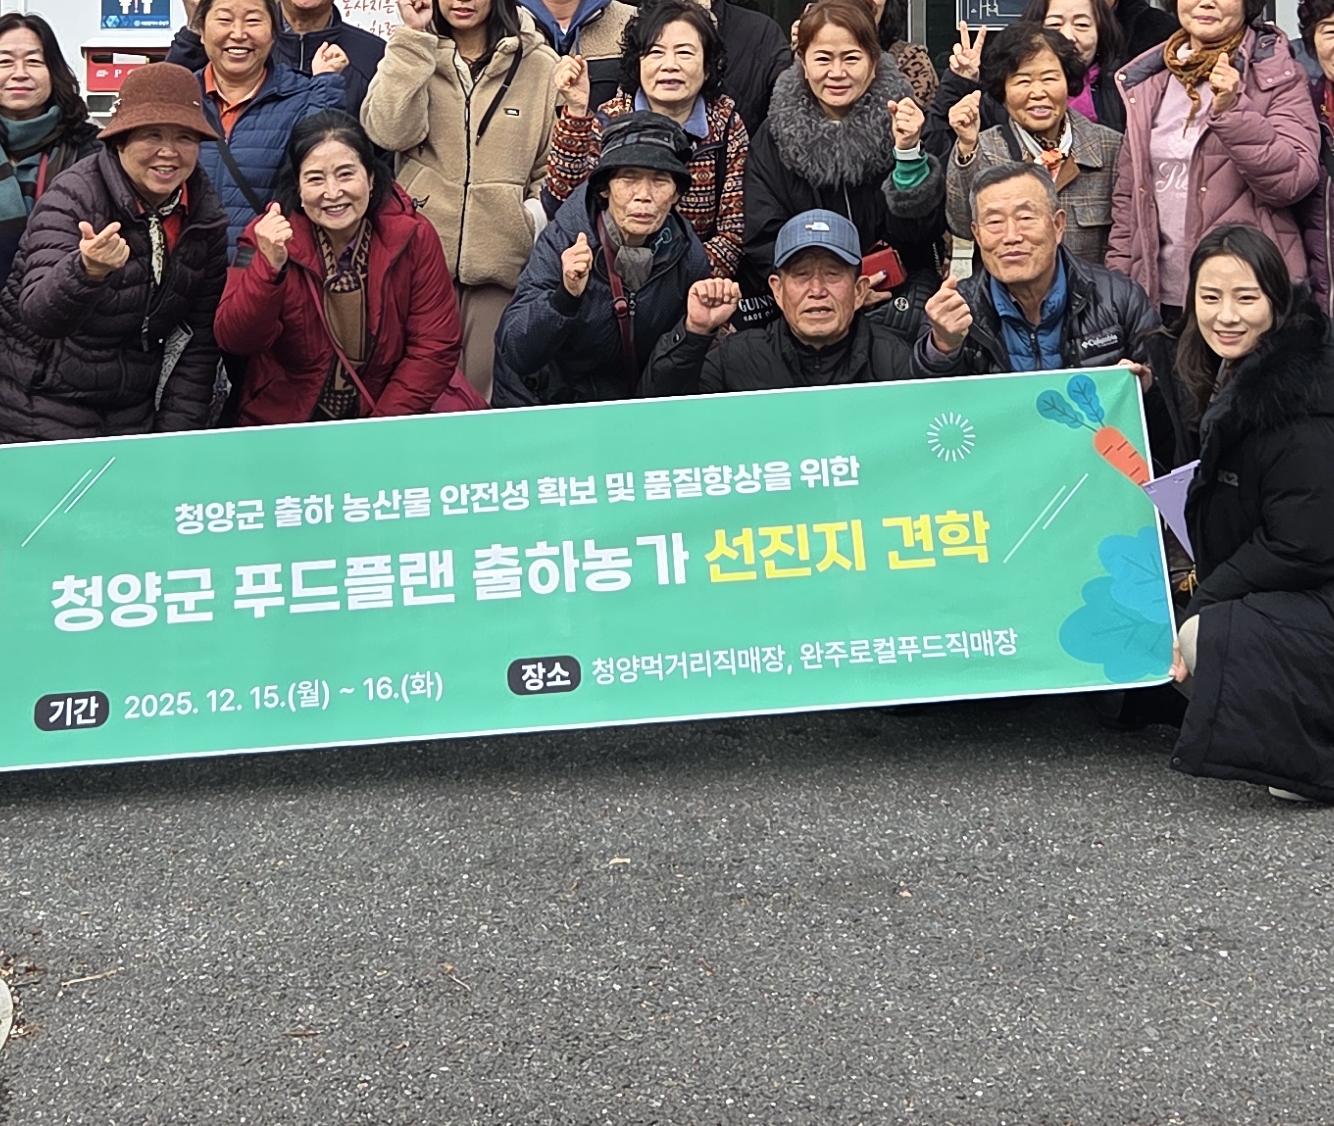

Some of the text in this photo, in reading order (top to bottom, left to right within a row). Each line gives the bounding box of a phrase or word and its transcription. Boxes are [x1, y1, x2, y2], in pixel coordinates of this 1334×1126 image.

[175, 455, 860, 535] 청양군 출하 농산물 안전성 확보 및 품질향상을 위한
[52, 509, 991, 632] 청양군 푸드플랜 출하농가 선진지 견학
[521, 627, 1018, 691] 장소 청양먹거리직매장, 완주로컬푸드직매장
[49, 697, 99, 726] 기간
[124, 692, 199, 720] 2025.
[207, 688, 242, 712] 12.
[251, 677, 330, 711] 15.(월)
[363, 669, 444, 704] 16.(화)
